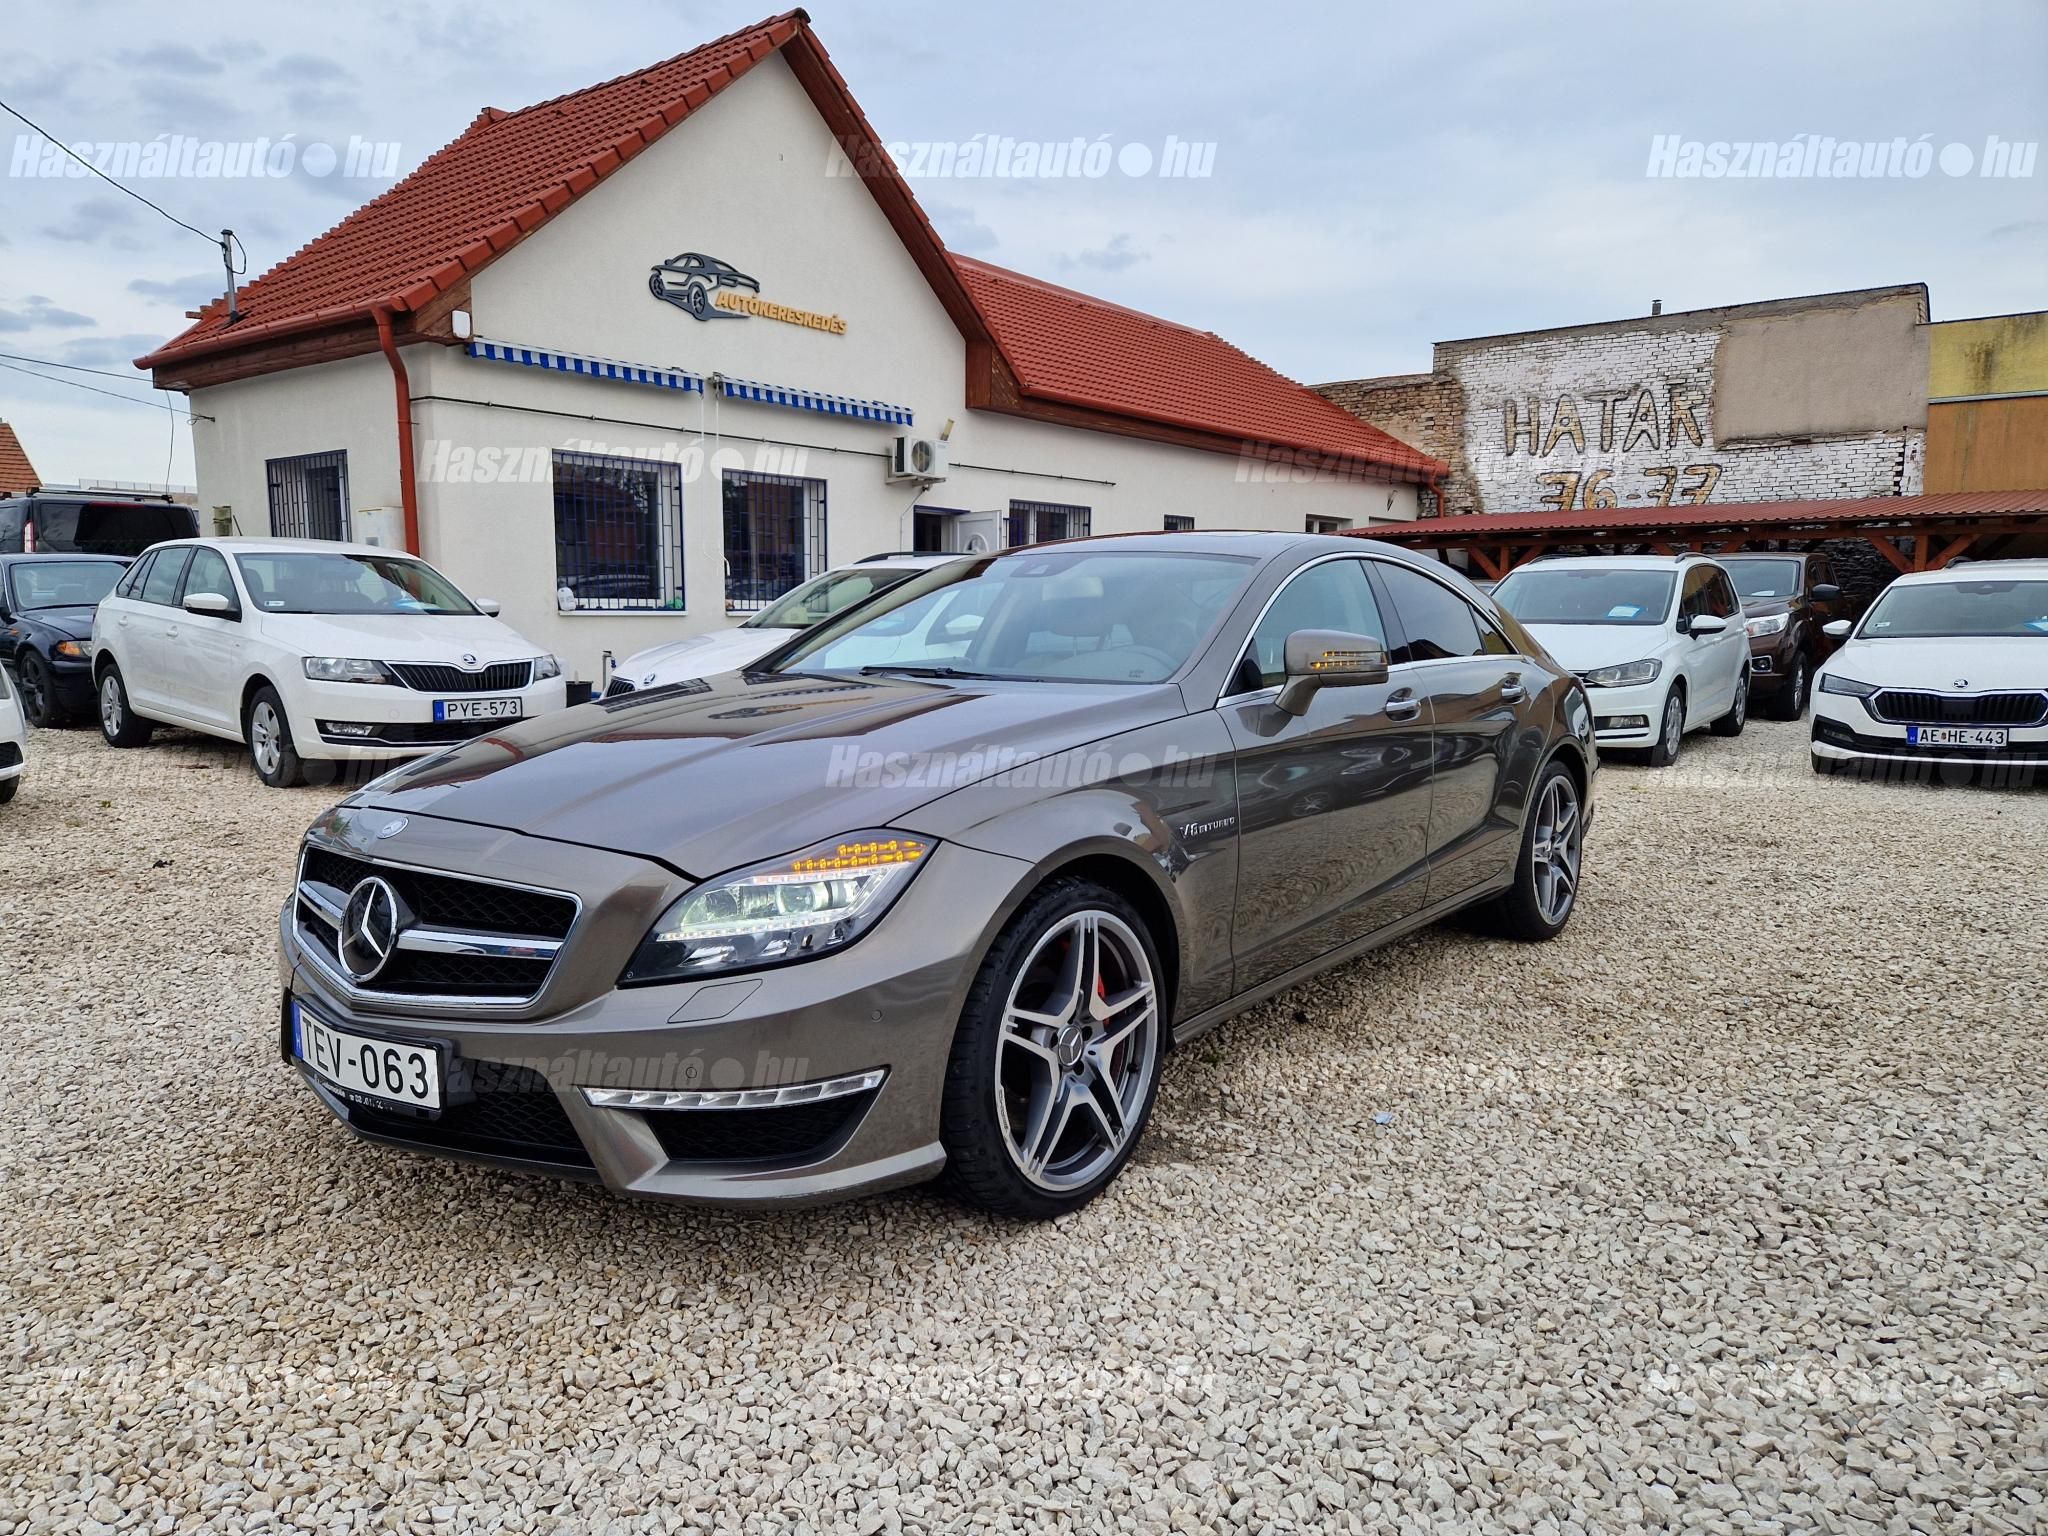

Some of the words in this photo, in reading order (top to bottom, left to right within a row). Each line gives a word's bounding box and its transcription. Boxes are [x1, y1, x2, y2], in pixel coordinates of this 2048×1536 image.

[715, 291, 848, 335] AUTÓKERESKEDÉS
[447, 701, 518, 718] PYE-573
[302, 1016, 429, 1099] TEV-063
